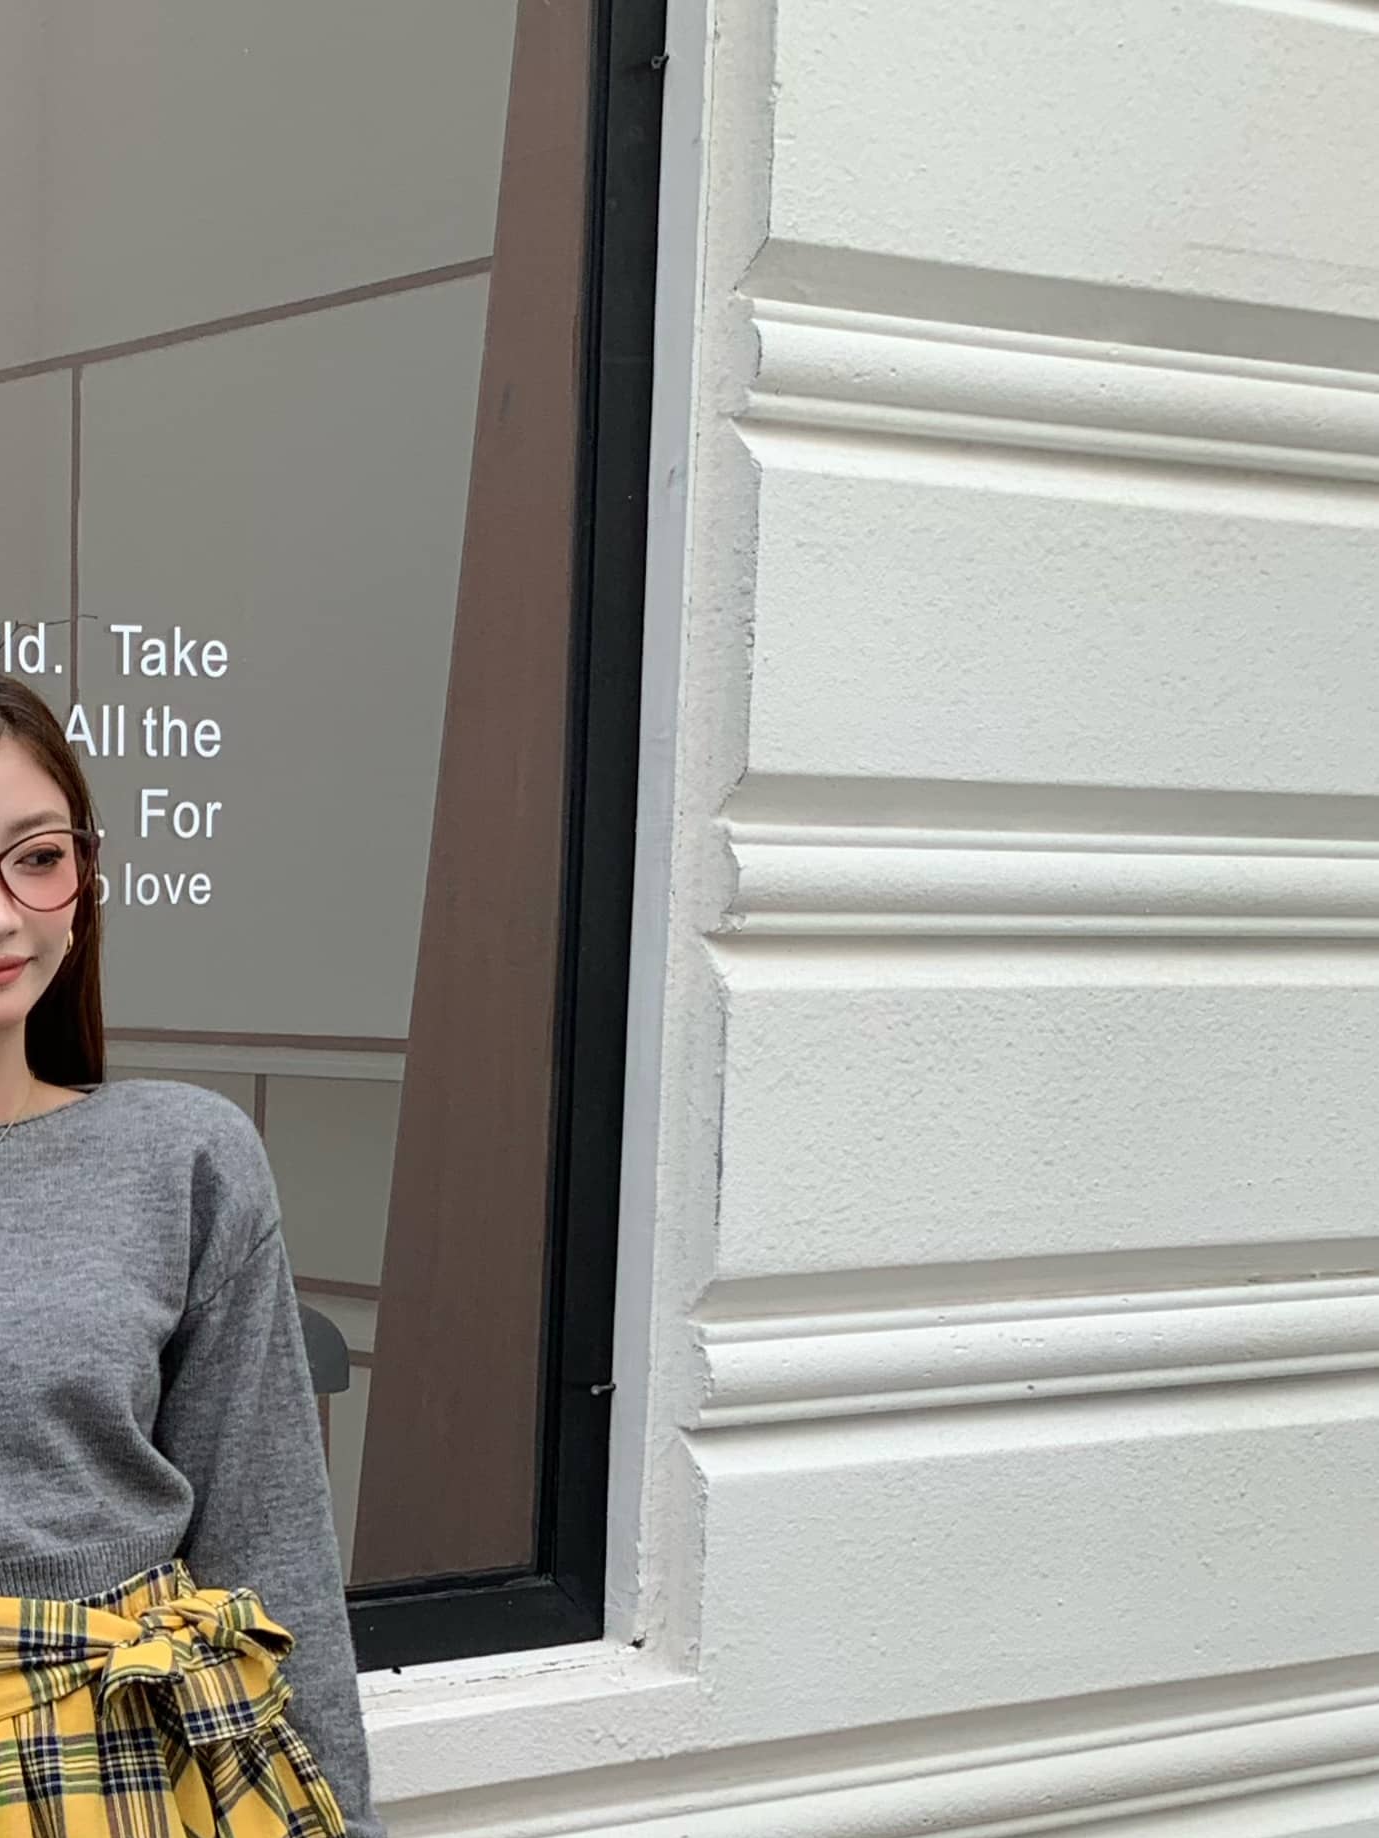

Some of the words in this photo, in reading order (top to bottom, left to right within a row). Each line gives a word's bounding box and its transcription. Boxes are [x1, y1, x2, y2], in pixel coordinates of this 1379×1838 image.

[111, 624, 228, 677] Take
[65, 704, 125, 757] All
[142, 706, 222, 758] the
[140, 789, 222, 838] For
[125, 863, 212, 905] love
